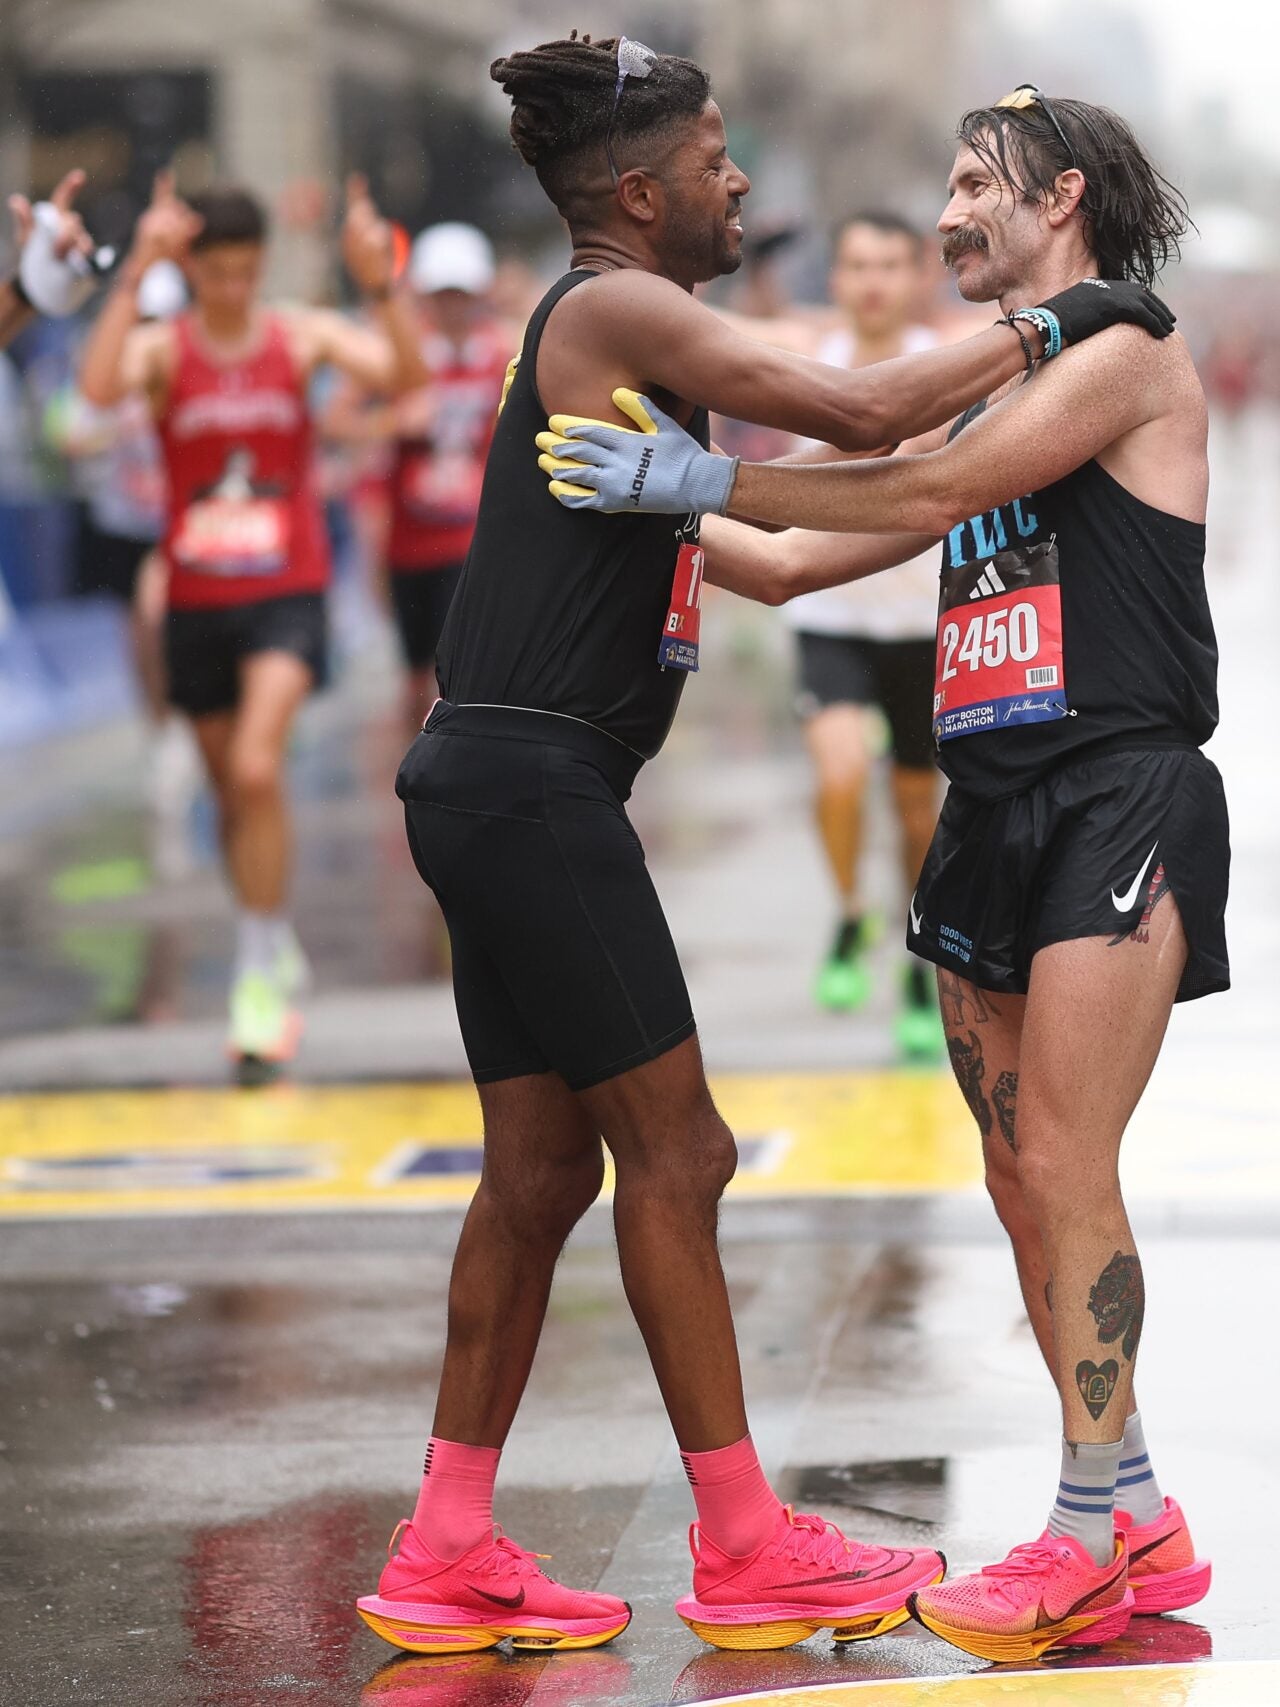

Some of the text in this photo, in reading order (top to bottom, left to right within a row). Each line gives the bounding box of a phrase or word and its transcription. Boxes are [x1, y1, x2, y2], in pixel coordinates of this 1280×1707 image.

[630, 446, 654, 505] HARDY
[942, 602, 1039, 682] 2450
[960, 705, 993, 720] BOSTON
[944, 715, 995, 734] MARATHON
[940, 924, 960, 940] GOOD
[938, 937, 960, 955] TRACK
